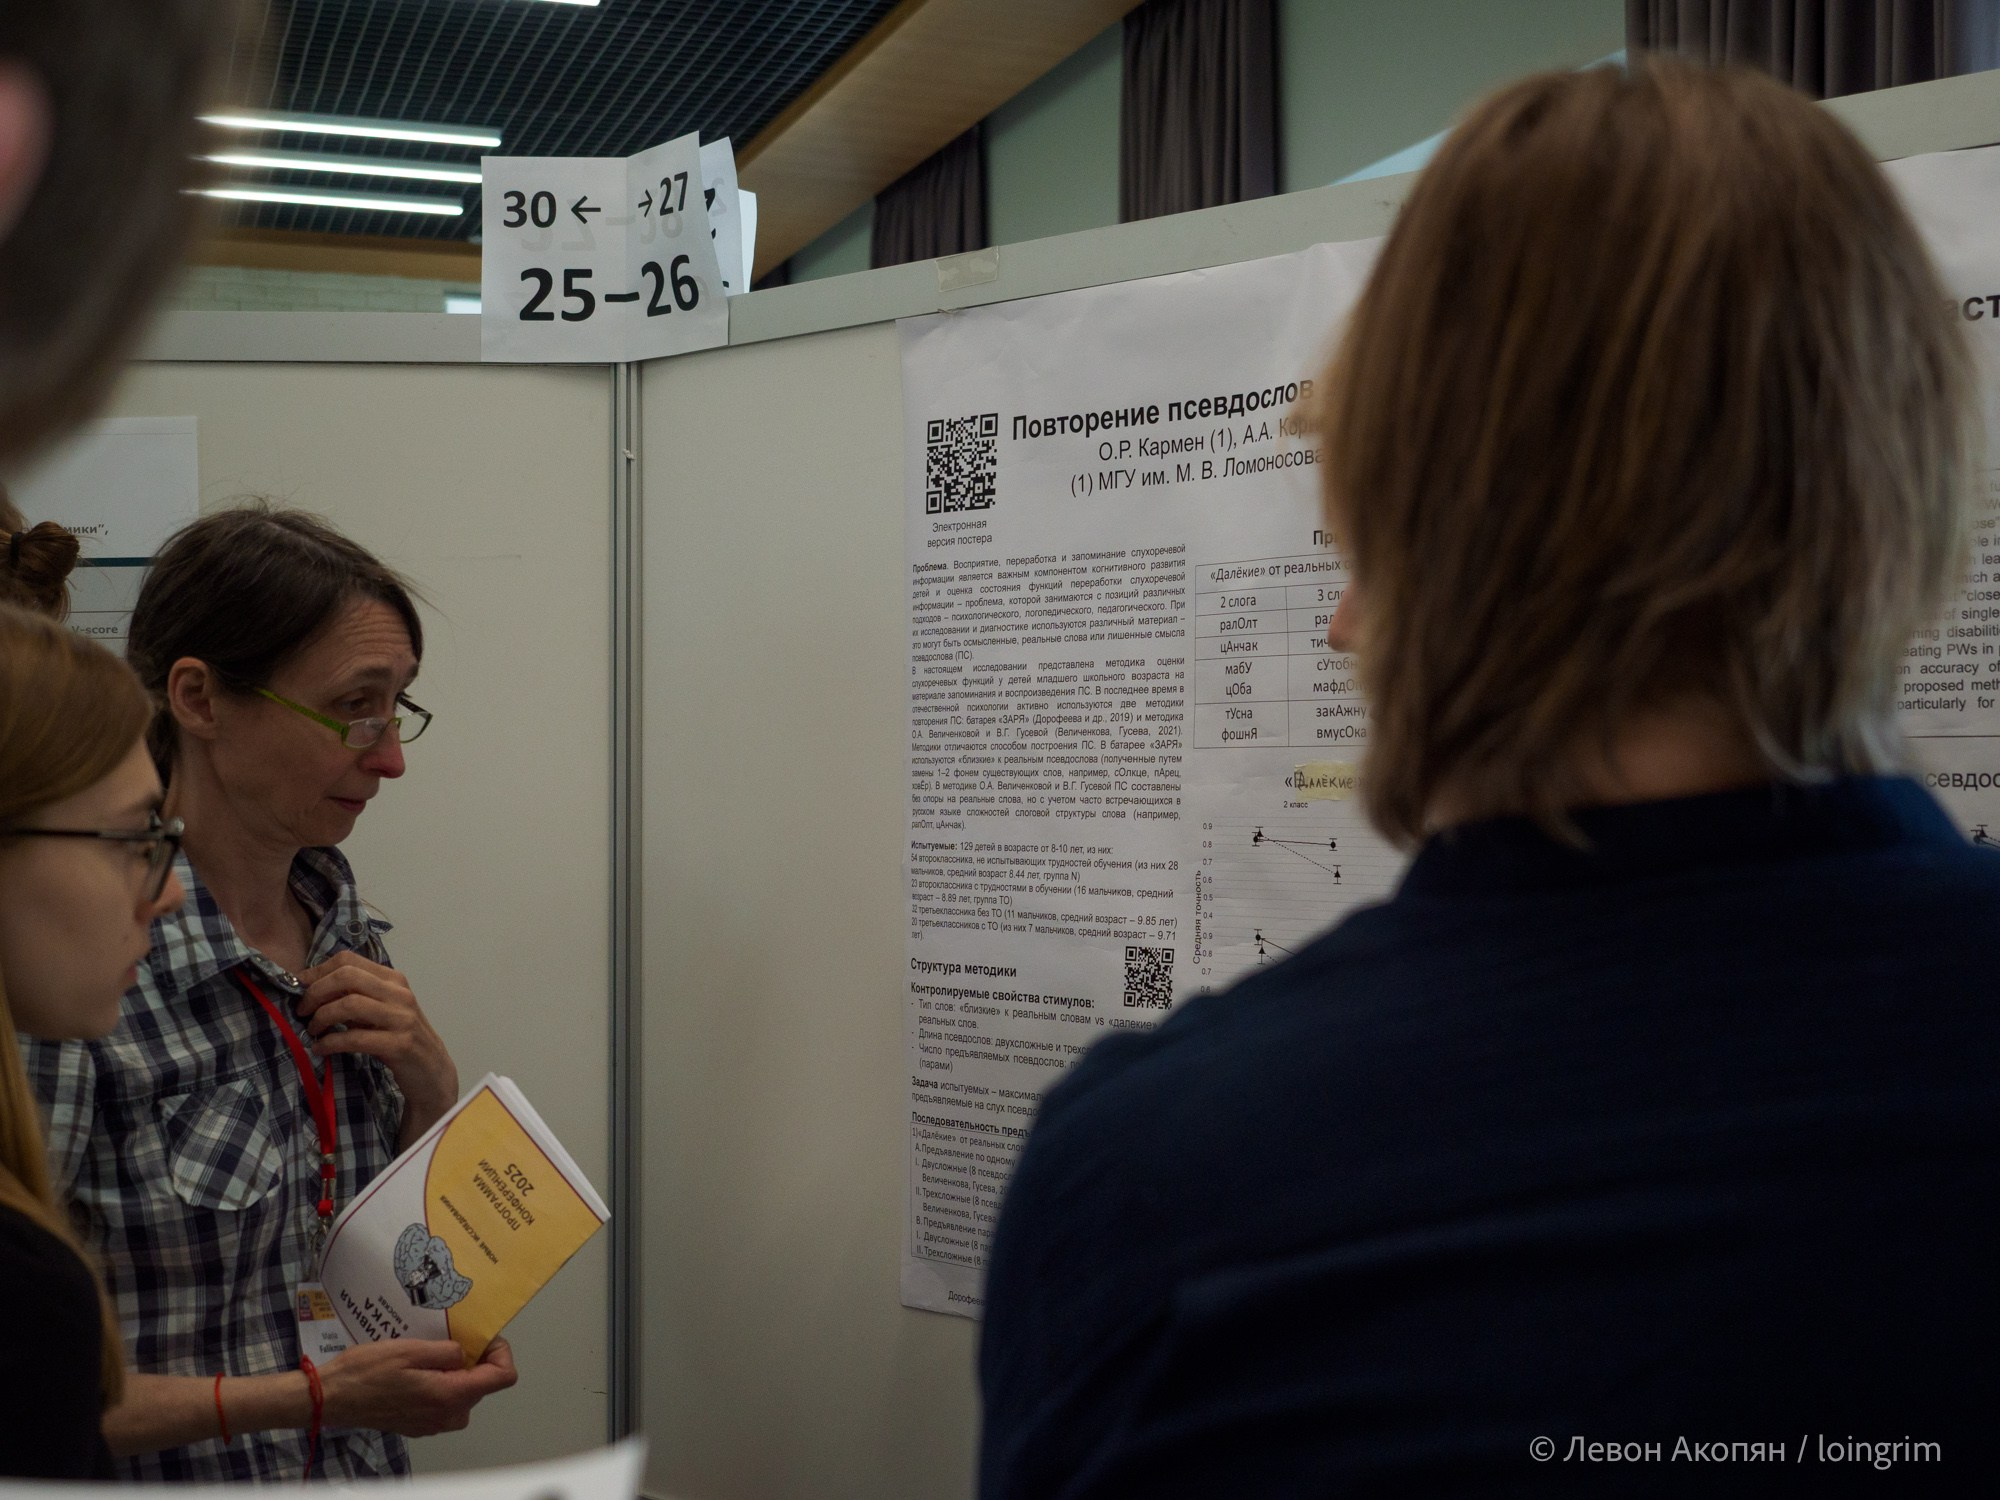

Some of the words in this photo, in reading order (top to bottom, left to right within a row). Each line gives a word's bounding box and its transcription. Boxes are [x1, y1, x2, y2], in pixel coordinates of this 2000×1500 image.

[502, 191, 557, 228] 30
[659, 171, 689, 217] 27
[1013, 406, 1159, 440] Повторение
[1168, 379, 1314, 422] псевдослов
[1099, 441, 1132, 461] О.Р.
[1139, 436, 1204, 458] Кармен
[1210, 428, 1237, 453] (1),
[1243, 423, 1273, 445] А.А.
[1071, 473, 1093, 497] (1)
[1099, 468, 1137, 491] МГУ
[1142, 470, 1170, 488] им.
[1177, 464, 1195, 483] М.
[1201, 461, 1217, 480] В.
[1223, 448, 1322, 478] Ломоносова
[933, 519, 987, 533] Электронная
[927, 536, 955, 549] версия
[957, 533, 992, 547] постера
[912, 562, 949, 574] Проблема.
[953, 559, 1000, 569] Восприятие,
[1006, 554, 1056, 566] переработка
[1071, 550, 1125, 561] запоминание
[1131, 545, 1185, 558] слухоречевой
[912, 575, 954, 586] информации
[958, 572, 992, 581] является
[997, 570, 1029, 579] важным
[1034, 566, 1086, 576] компонентом
[1092, 562, 1145, 573] когнитивного
[1150, 559, 1185, 571] развития
[1269, 566, 1281, 575] от
[1284, 561, 1341, 577] реальных
[912, 588, 929, 598] детей
[946, 587, 972, 596] оценка
[979, 584, 1020, 593] состояния
[1028, 580, 1062, 592] функций
[1070, 576, 1122, 589] переработки
[1130, 571, 1185, 586] слухоречевой
[1220, 596, 1226, 608] 2
[1228, 595, 1256, 608] слога
[1318, 589, 1323, 601] 3
[1961, 607, 2000, 621] single
[1220, 617, 1258, 632] ралОлт
[1220, 641, 1258, 655] цАнчак
[1947, 644, 1977, 655] PWs
[1982, 643, 1993, 655] in
[912, 666, 916, 675] В
[924, 665, 962, 674] настоящем
[972, 663, 1026, 672] исследовании
[1038, 660, 1094, 671] представлена
[1105, 658, 1144, 668] методика
[1156, 657, 1184, 666] оценки
[1920, 663, 1979, 675] accuracy
[912, 679, 957, 689] слухоречевых
[962, 676, 993, 687] функций
[998, 677, 1002, 686] у
[1007, 674, 1031, 685] детей
[1036, 674, 1077, 684] младшего
[1083, 673, 1125, 682] школьного
[1131, 672, 1169, 682] возраста
[1174, 671, 1184, 679] на
[1904, 680, 1964, 694] proposed
[1226, 684, 1252, 697] цОба
[1898, 697, 1966, 712] particularly
[1978, 696, 1994, 708] for
[1226, 708, 1253, 719] тУсна
[1221, 728, 1257, 742] фошнЯ
[911, 840, 957, 851] Испытуемые:
[960, 841, 973, 850] 129
[974, 842, 995, 852] детей
[1004, 844, 1038, 853] возрасте
[1050, 843, 1067, 853] 8-10
[1070, 846, 1084, 854] лет,
[1087, 846, 1095, 854] из
[1193, 919, 1201, 964] Средняя
[910, 957, 960, 975] Структура
[964, 964, 1016, 977] методики
[911, 982, 989, 1000] Контролируемые
[992, 990, 1039, 1003] свойства
[1042, 995, 1094, 1009] стимулов:
[920, 998, 931, 1009] Тип
[934, 1002, 954, 1011] слов:
[959, 1002, 1000, 1015] «близкие»
[1012, 1009, 1056, 1020] реальным
[1060, 1013, 1090, 1023] словам
[1094, 1017, 1104, 1025] vs
[1108, 1018, 1157, 1034] «далекие»
[503, 1162, 535, 1197] 2025
[477, 1159, 535, 1226] КОНФЕРЕНЦИИ
[473, 1173, 521, 1231] ПРОГРАММА
